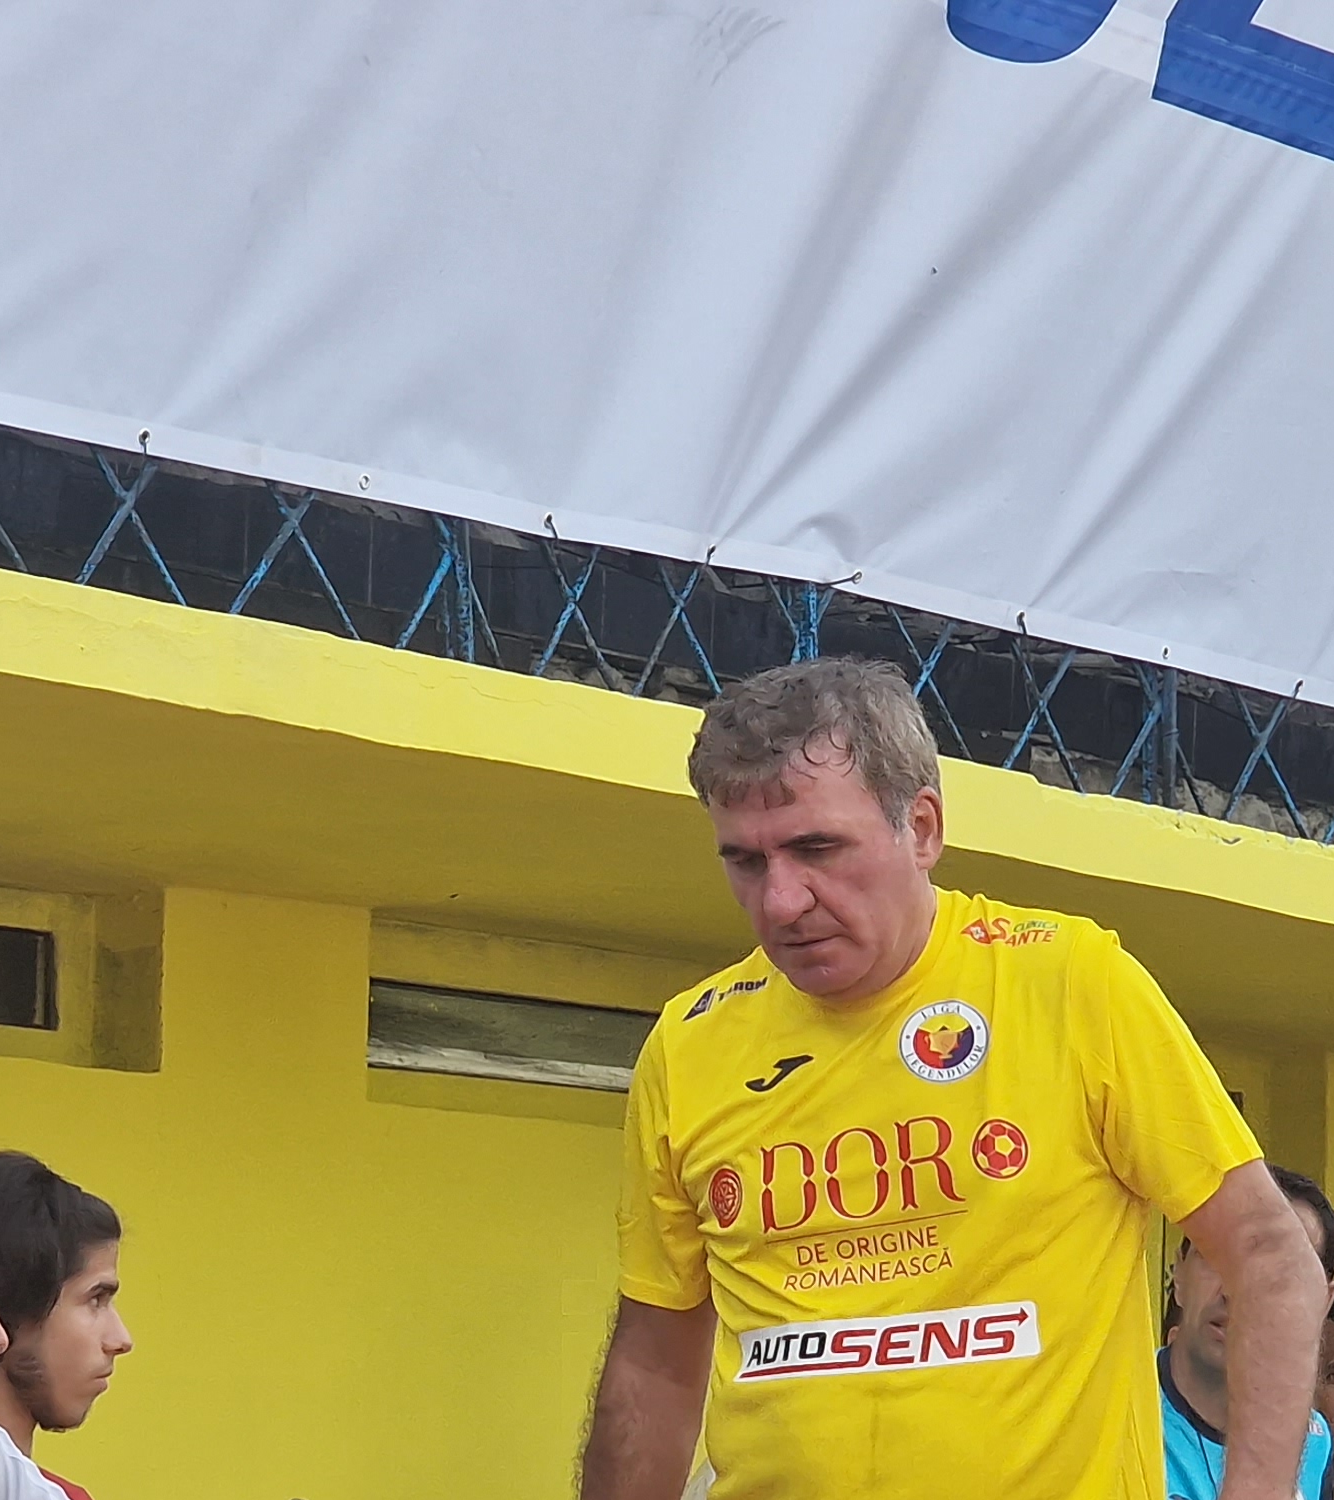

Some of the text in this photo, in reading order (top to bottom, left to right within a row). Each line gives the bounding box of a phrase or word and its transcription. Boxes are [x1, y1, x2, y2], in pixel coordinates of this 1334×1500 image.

[920, 1004, 961, 1020] LIGA
[905, 1044, 984, 1080] LEGENDELOR
[760, 1116, 967, 1234] DOR
[796, 1225, 939, 1267] DE ORIGINE
[783, 1247, 954, 1292] ROMÂNEASCĂ
